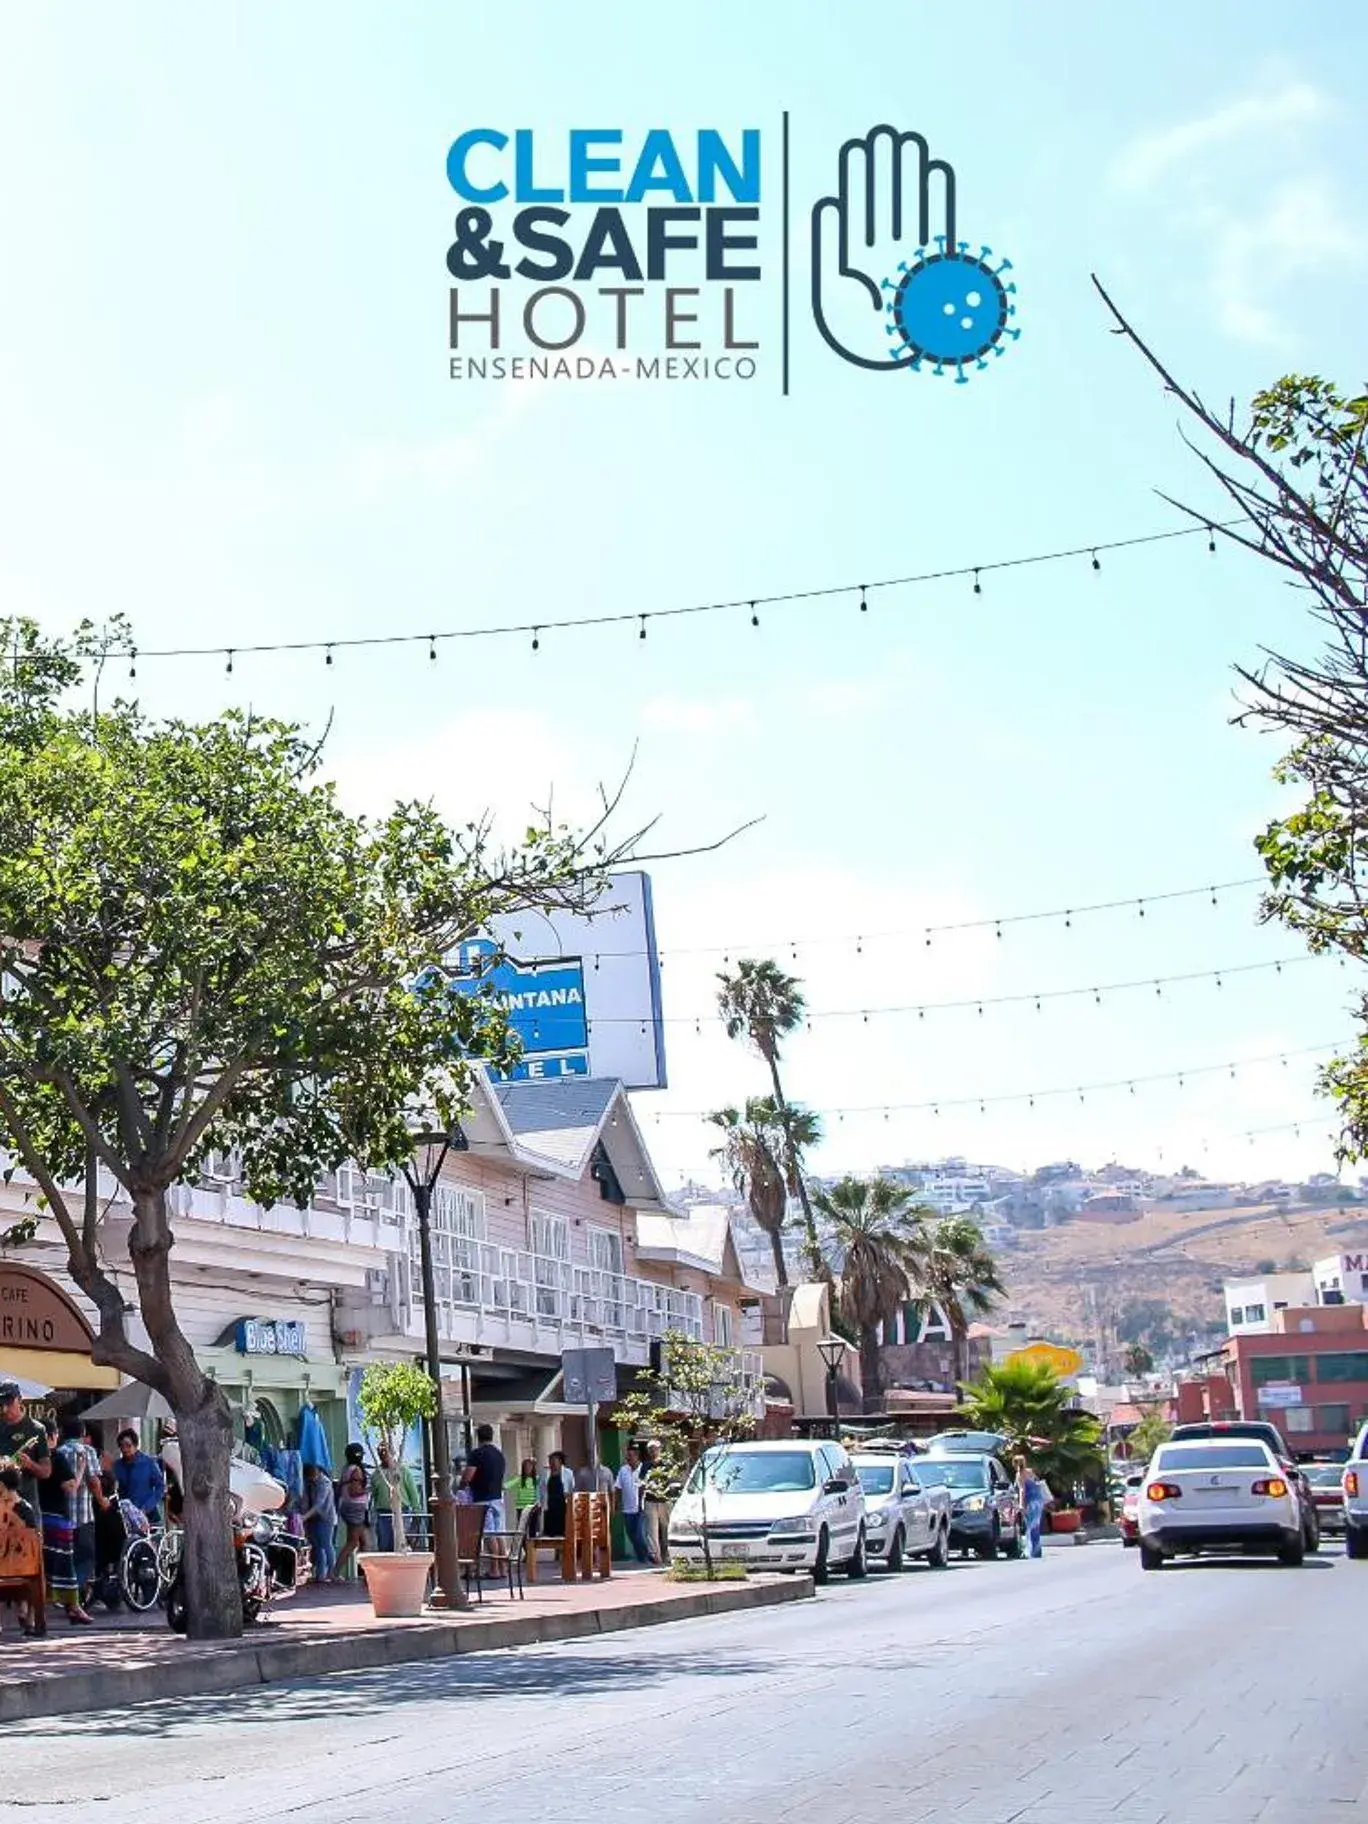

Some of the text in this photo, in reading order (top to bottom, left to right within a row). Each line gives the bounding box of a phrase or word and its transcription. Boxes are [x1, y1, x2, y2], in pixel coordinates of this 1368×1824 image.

[1, 1286, 29, 1303] CAFE
[245, 1320, 309, 1354] Blue Shell
